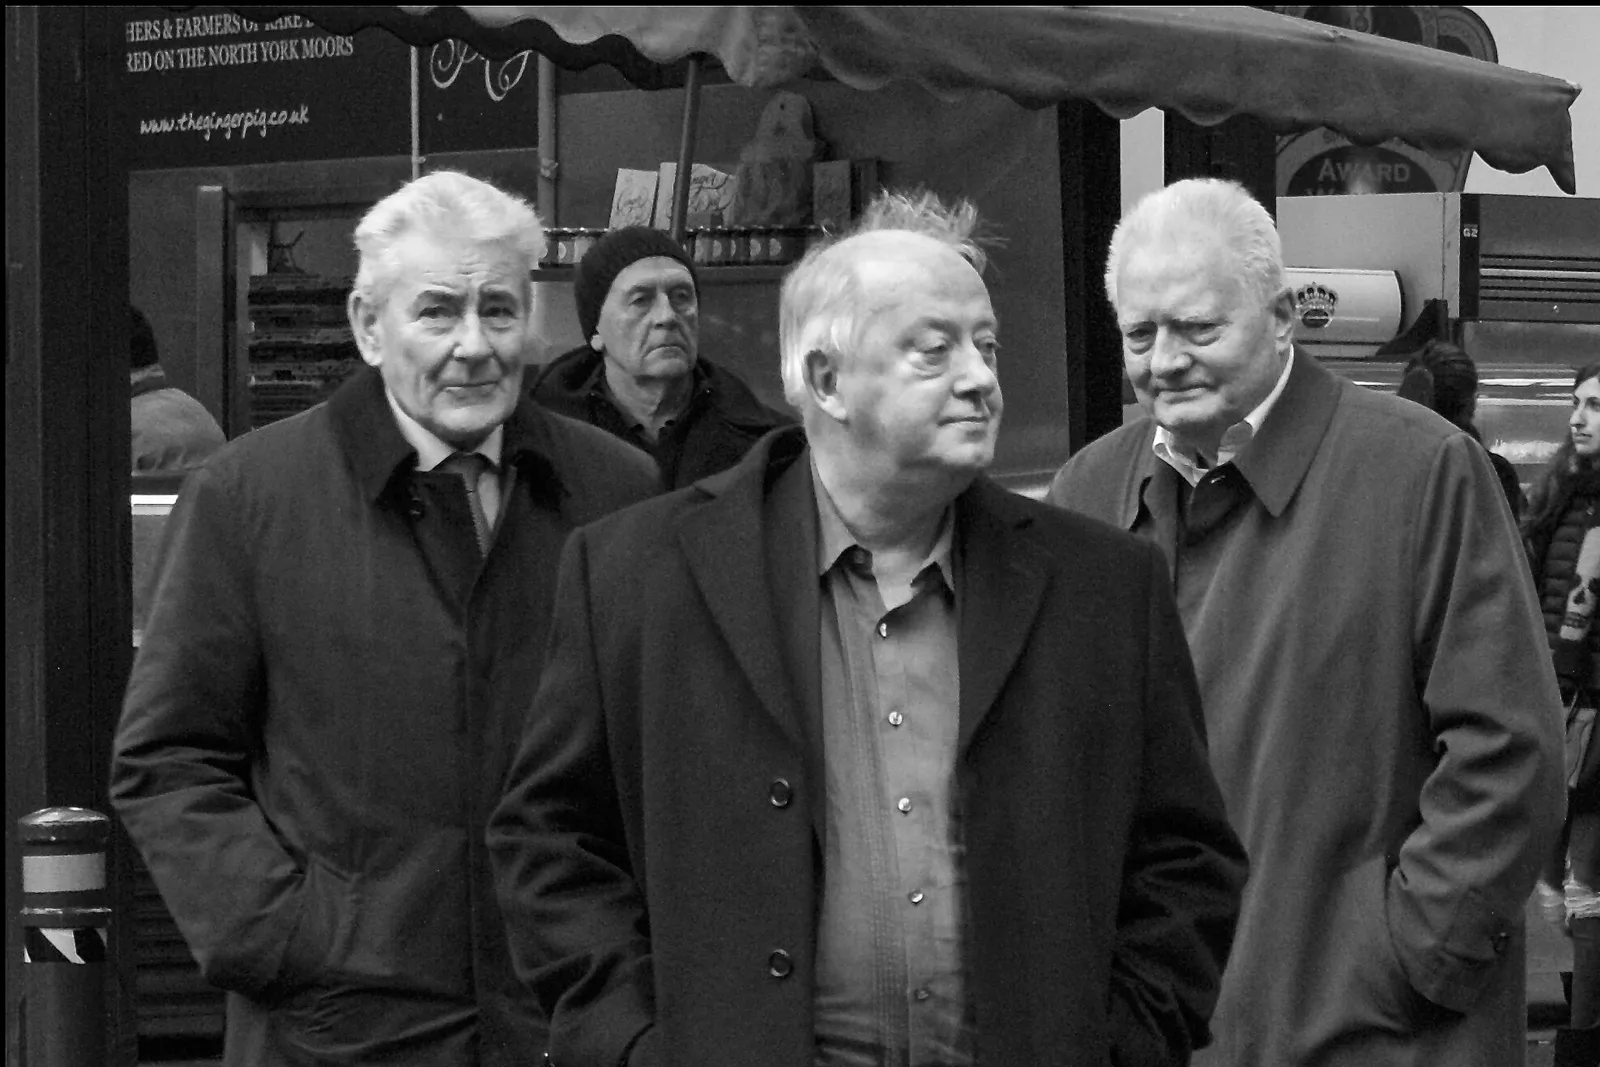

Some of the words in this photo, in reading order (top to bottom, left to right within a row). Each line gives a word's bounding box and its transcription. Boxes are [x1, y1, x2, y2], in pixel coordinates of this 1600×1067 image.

[163, 18, 173, 40] &
[176, 13, 240, 39] FARMERS
[154, 49, 174, 71] ON
[177, 46, 207, 69] THE
[209, 43, 258, 67] NORTH
[260, 39, 299, 62] YORK
[302, 36, 354, 60] MOORS
